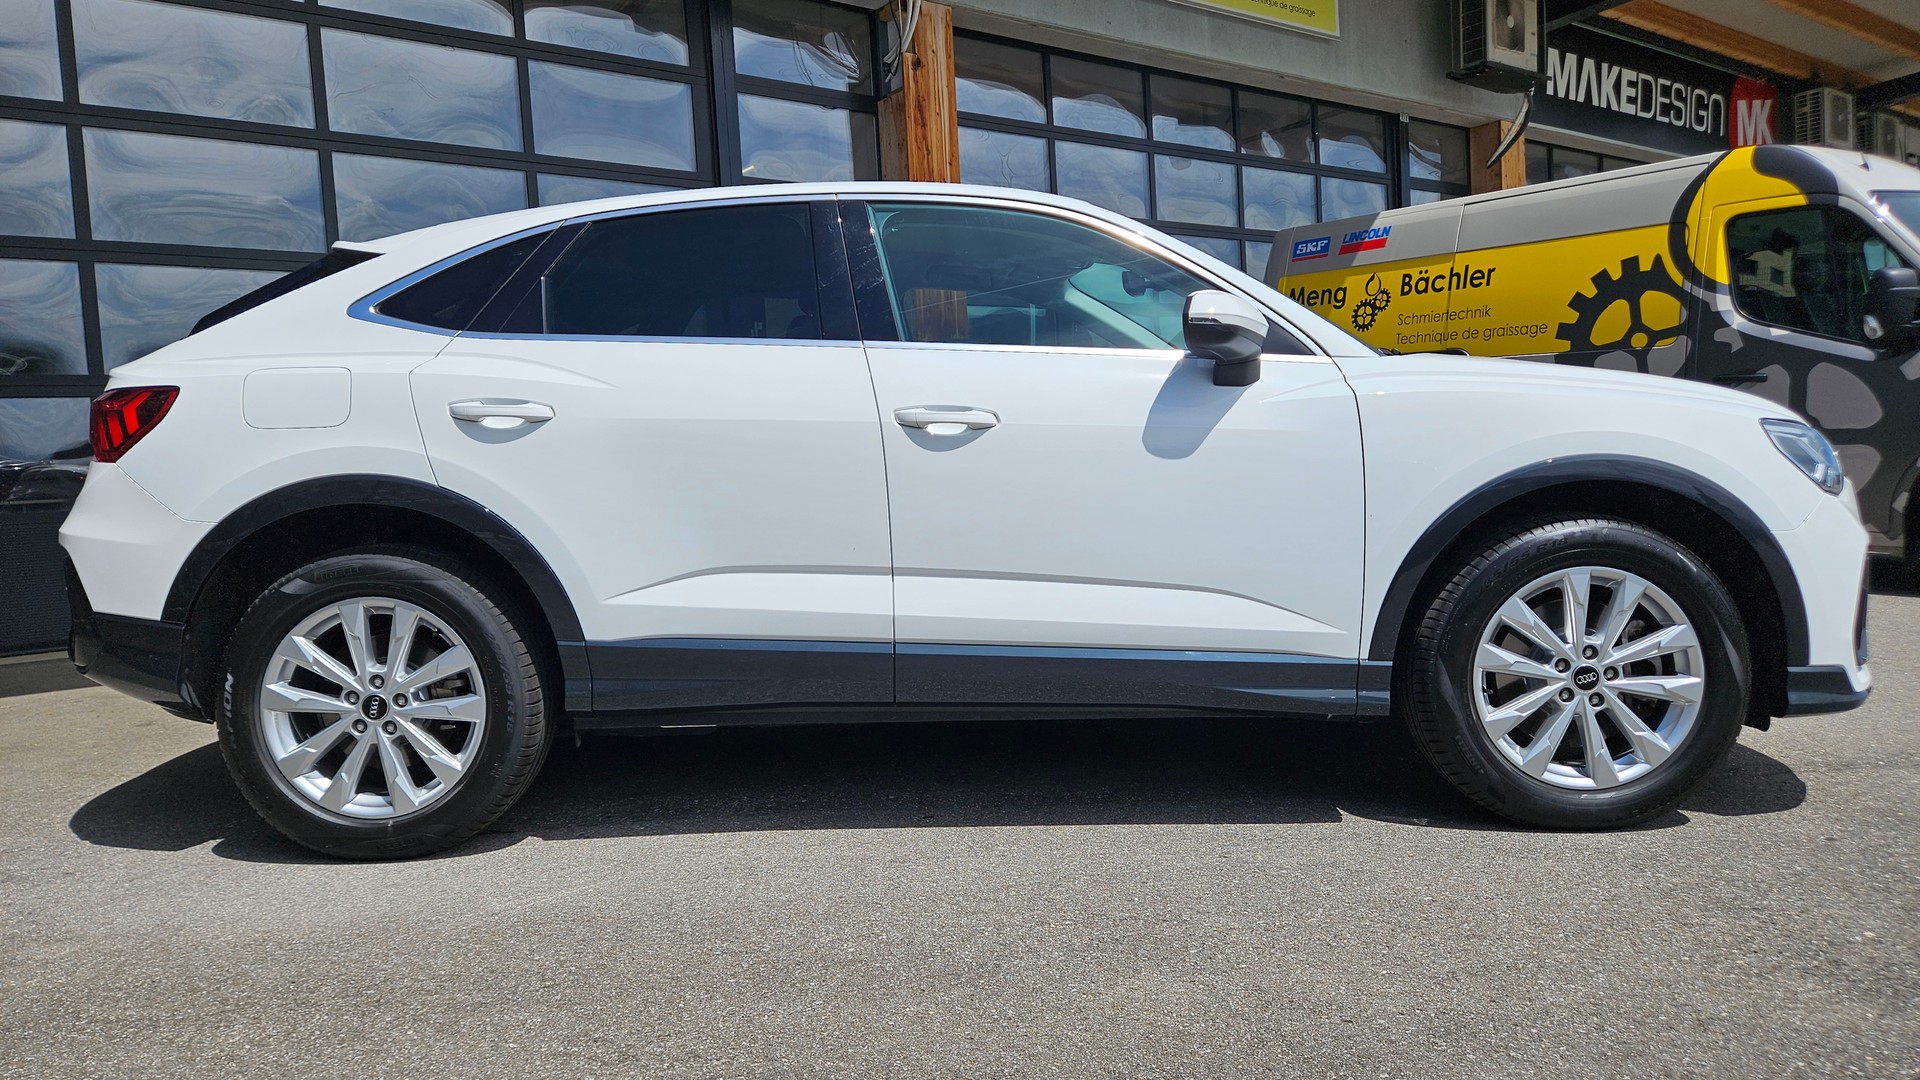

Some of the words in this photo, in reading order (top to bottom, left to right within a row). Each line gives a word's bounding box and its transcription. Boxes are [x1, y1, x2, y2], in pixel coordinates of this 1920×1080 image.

[1280, 2, 1288, 10] de
[1736, 99, 1773, 146] MK
[1342, 225, 1392, 244] LINCOLN
[1296, 239, 1329, 255] SKF
[1289, 286, 1347, 310] Meng
[1400, 265, 1496, 297] Bächler
[1397, 305, 1491, 326] Schmiertechnik
[1396, 330, 1458, 345] Technique
[1462, 327, 1479, 340] de
[1483, 323, 1548, 341] graissage
